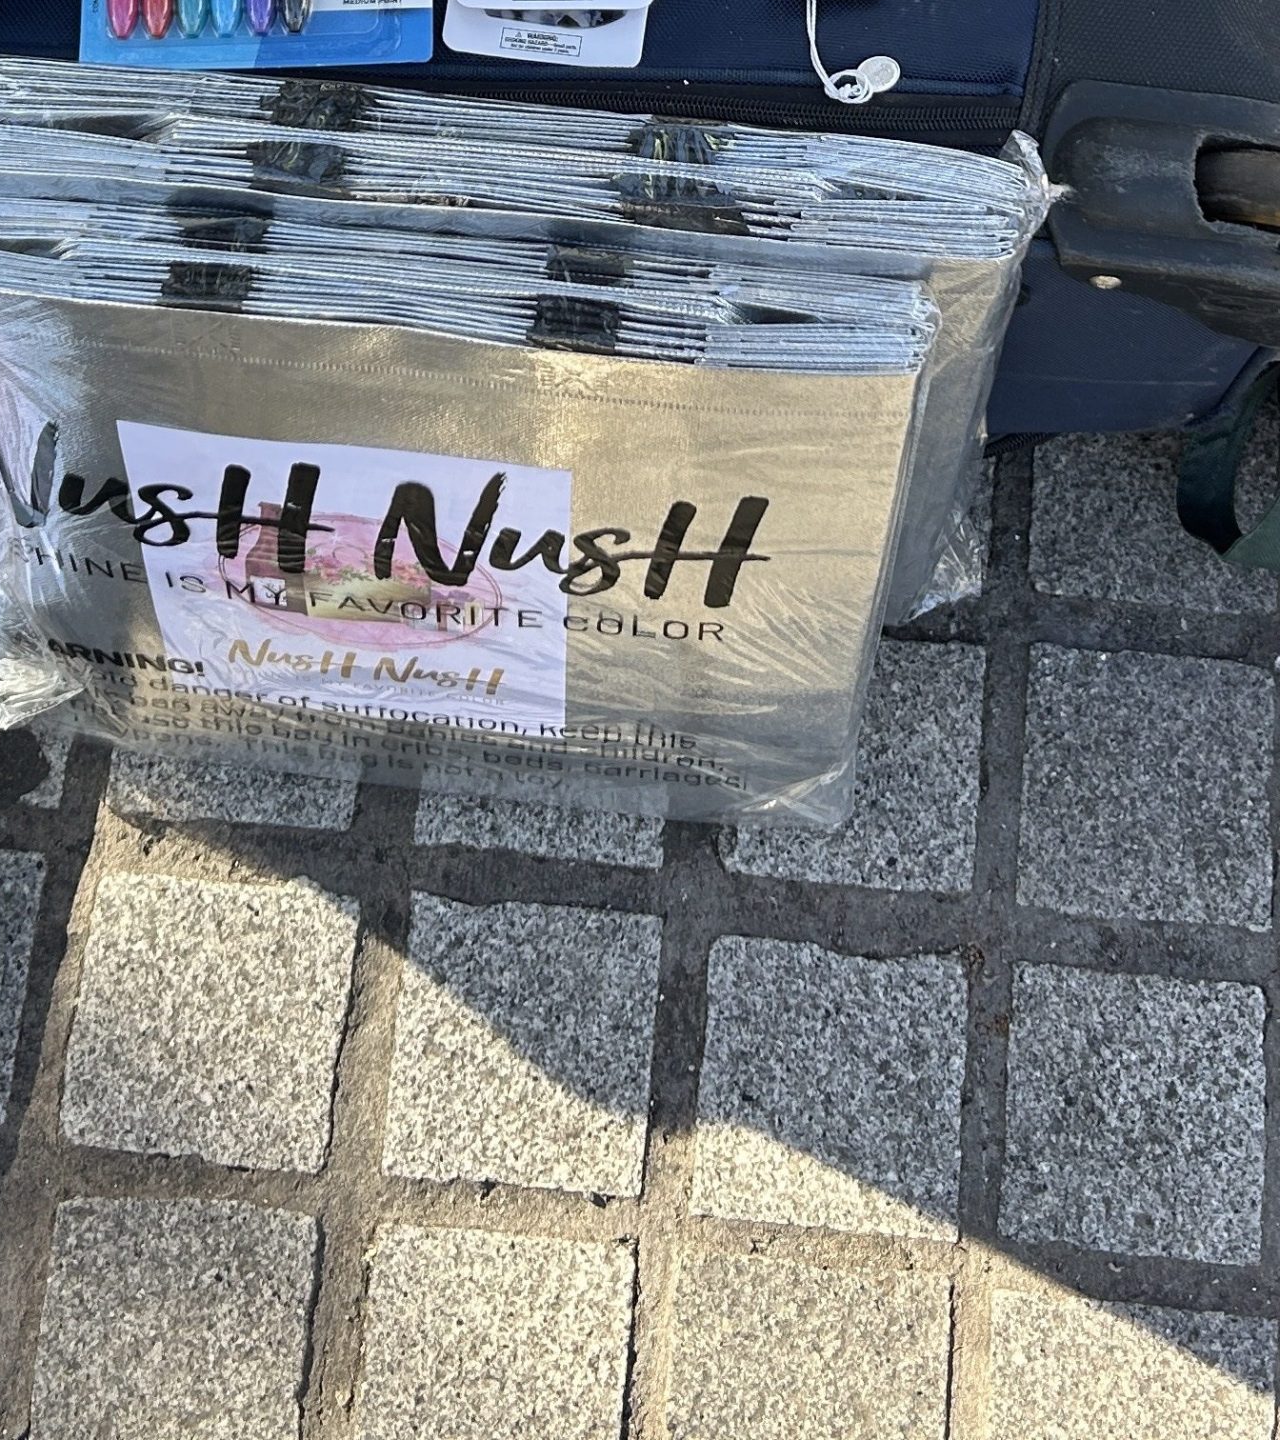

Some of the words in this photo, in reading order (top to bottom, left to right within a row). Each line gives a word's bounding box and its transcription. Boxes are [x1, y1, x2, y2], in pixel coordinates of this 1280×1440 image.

[374, 471, 771, 608] NusH
[165, 571, 207, 594] IS
[226, 579, 287, 607] MY
[309, 591, 543, 629] FAVORITE
[563, 613, 726, 643] COLOR
[228, 638, 358, 679] NusH
[374, 655, 505, 695] NusH
[149, 674, 267, 703] danger
[278, 693, 309, 709] of
[322, 698, 528, 736] suffocation,
[540, 720, 623, 745] keep
[636, 718, 697, 750] this
